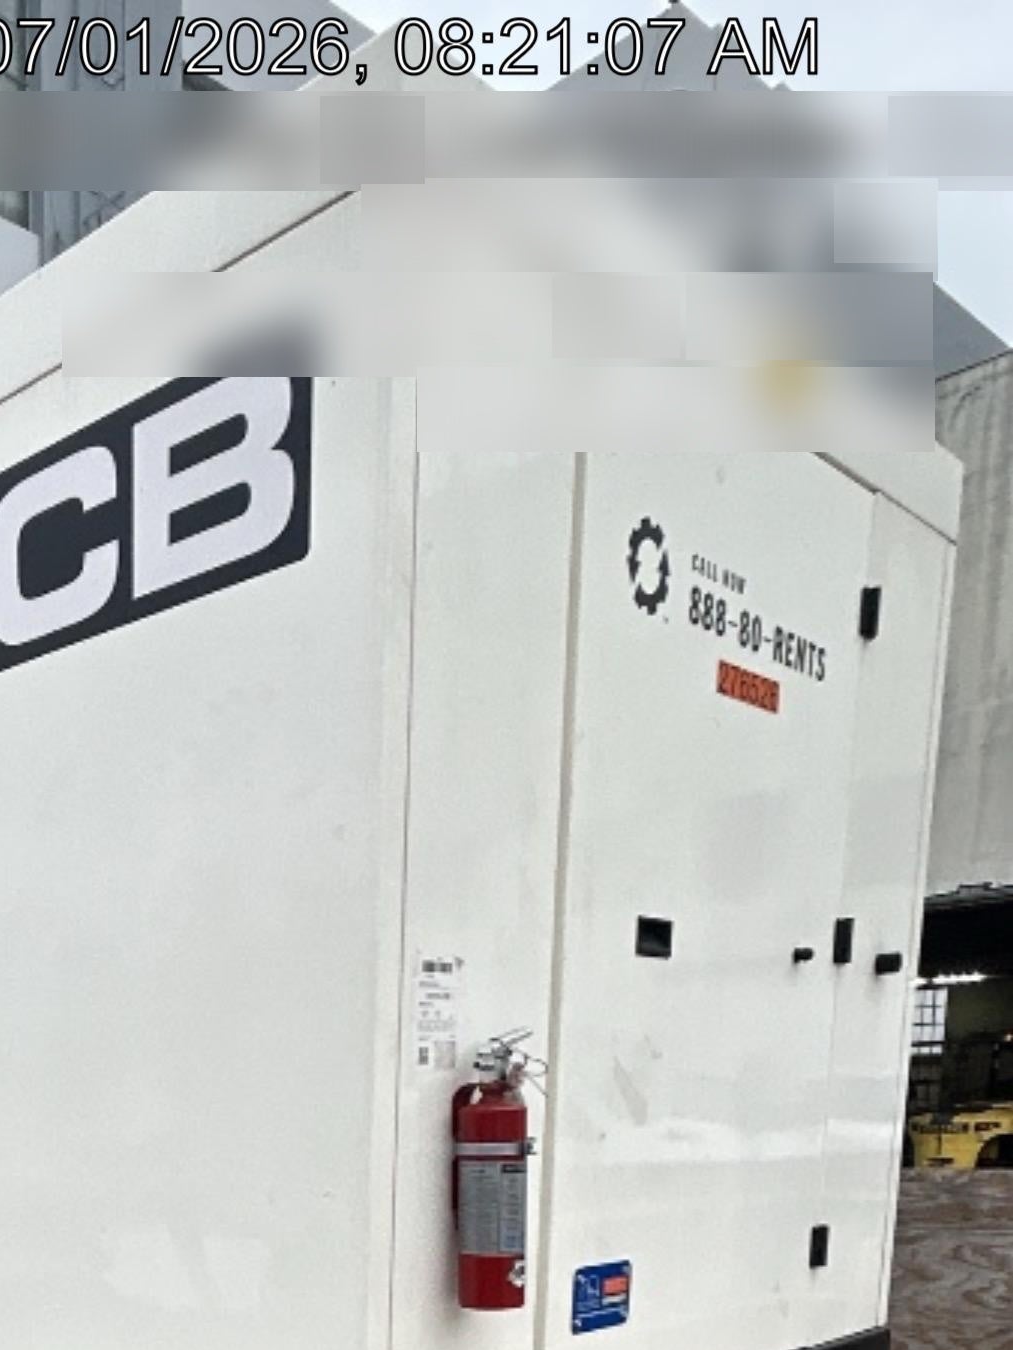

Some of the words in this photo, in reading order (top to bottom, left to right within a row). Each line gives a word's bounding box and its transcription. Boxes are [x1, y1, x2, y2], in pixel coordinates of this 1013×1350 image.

[691, 553, 717, 583] CALL
[722, 569, 746, 595] NOW
[689, 585, 826, 682] 888-80-RENTS
